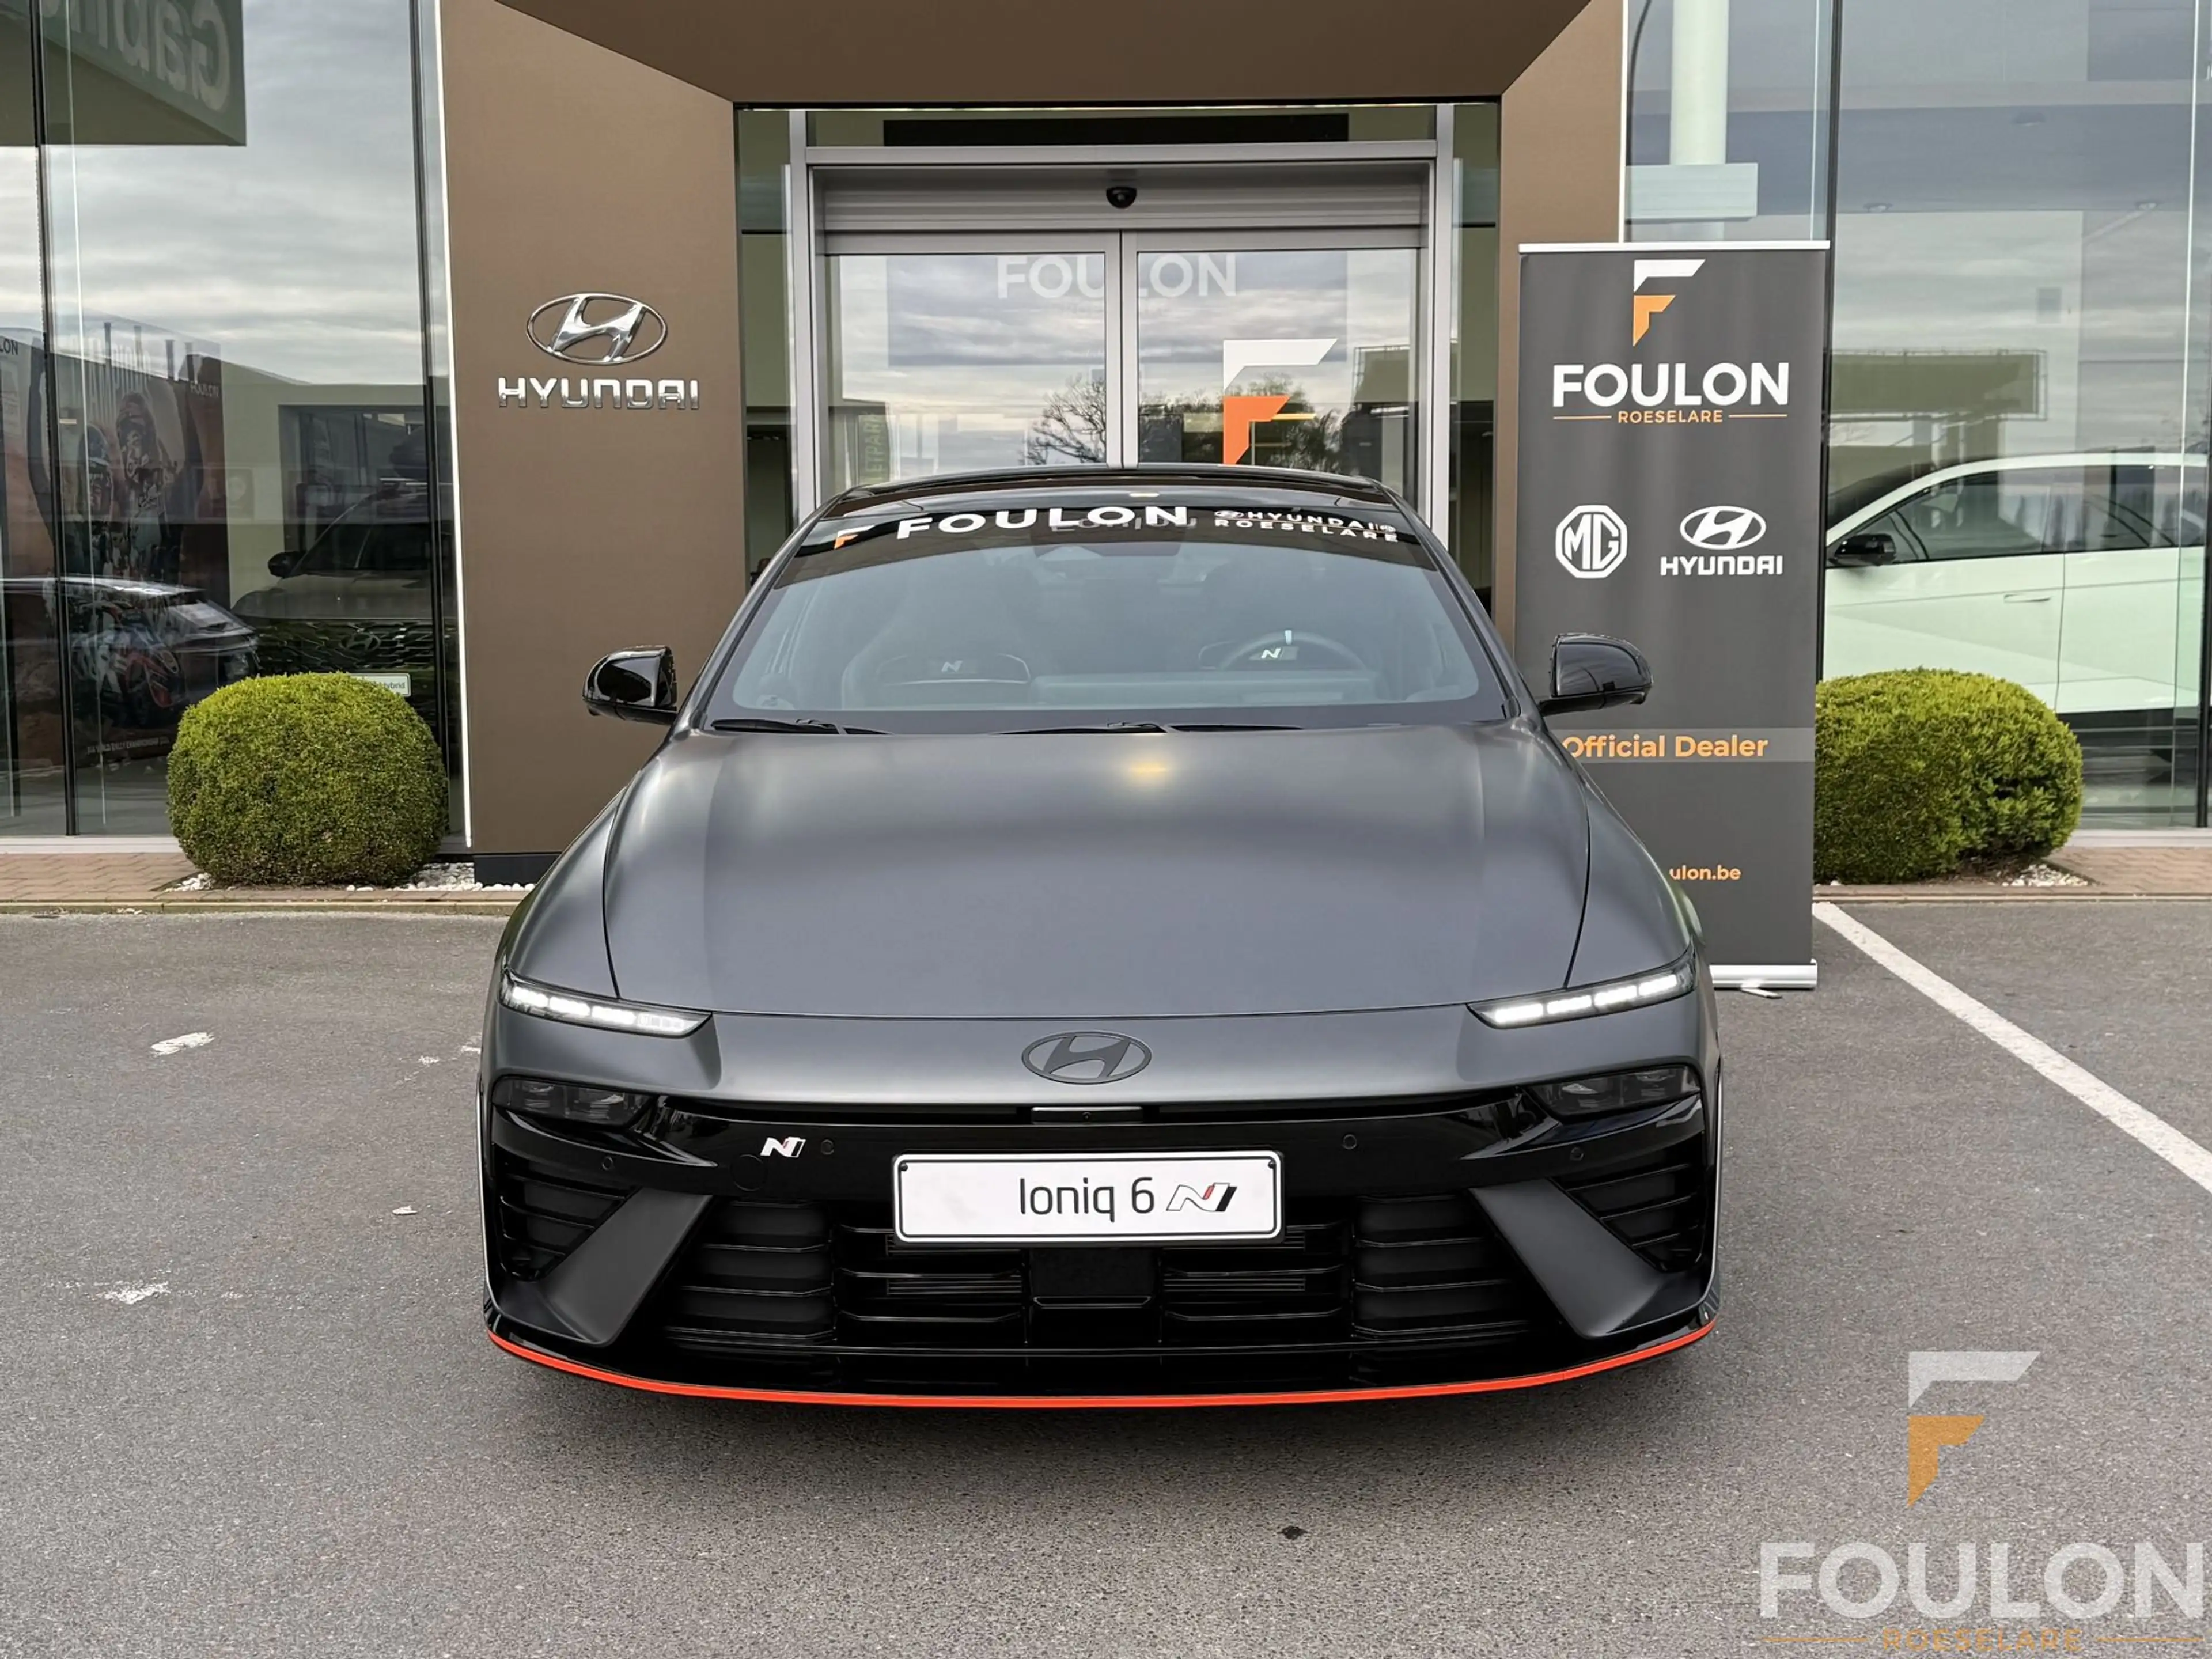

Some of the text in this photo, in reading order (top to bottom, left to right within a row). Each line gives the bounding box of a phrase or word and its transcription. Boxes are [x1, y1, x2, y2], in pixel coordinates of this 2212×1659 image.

[997, 254, 1236, 298] FOUON
[498, 377, 700, 410] HYUNDAI
[1552, 363, 1789, 407] FOULON
[1618, 410, 1722, 423] ROESELARE
[897, 506, 1187, 539] FOULON
[1215, 519, 1398, 543] ROESELARE
[1248, 511, 1375, 532] HYUNDAI
[1661, 555, 1783, 576] HYUNDAI
[1562, 734, 1768, 757] Official Dealer
[1020, 1179, 1115, 1222] Ioniq
[1131, 1177, 1154, 1214] 6
